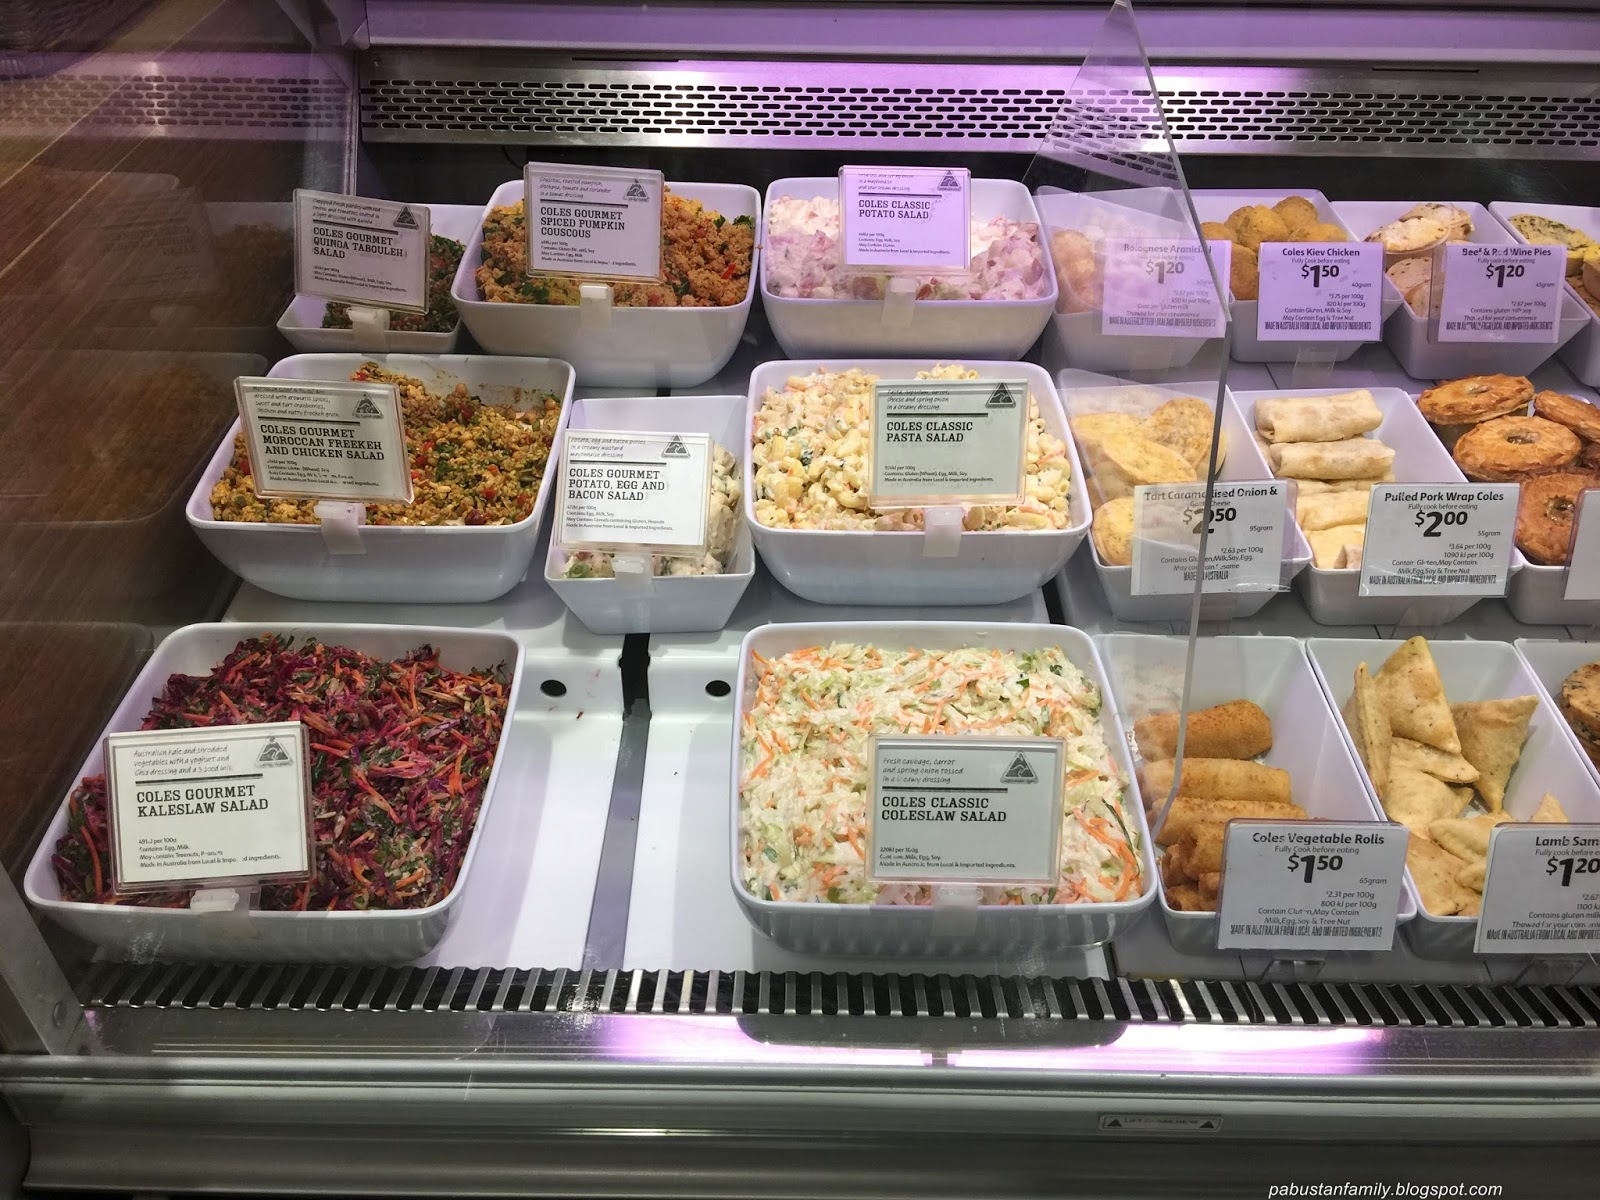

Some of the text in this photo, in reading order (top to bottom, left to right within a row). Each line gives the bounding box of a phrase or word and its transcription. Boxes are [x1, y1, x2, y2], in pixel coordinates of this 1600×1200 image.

[859, 200, 930, 209] COLES CLASSIC
[541, 207, 623, 220] COLES GOURMET
[859, 210, 929, 219] POTATO SALAD
[541, 217, 625, 230] SPICED PUMPKIN
[313, 227, 393, 245] COLES GOURMET
[541, 227, 591, 238] COUSCOUS
[313, 237, 403, 256] QUINOA TABOULEH
[1124, 244, 1168, 253] Bolognese
[1283, 248, 1359, 256] Coles Kiev Chicken
[1511, 248, 1532, 256] Wine
[1535, 248, 1551, 256] Pies
[313, 247, 345, 258] SALAD
[261, 425, 355, 438] COLES GOURMET
[887, 422, 973, 431] COLES CLASSIC
[263, 435, 382, 450] MOROCCAN FREEKEH
[887, 433, 963, 442] PASTA SALAD
[265, 446, 384, 460] AND CHICKEN SALAD
[570, 469, 660, 479] COLES GOURMET
[569, 479, 665, 490] POTATO, EGG AND
[568, 490, 644, 500] BACON SALAD
[1144, 492, 1165, 501] Tart
[1237, 488, 1267, 497] Onion
[1385, 492, 1504, 502] Pulled Pork Wrap Coles
[190, 757, 215, 765] yoghurt
[137, 785, 255, 803] COLES GOURMET
[138, 799, 268, 817] KALESLAW SALAD
[882, 797, 989, 808] COLES CLASSIC
[882, 810, 1006, 821] COLESLAW SALAD
[1253, 832, 1384, 845] Coles Vegetable Rolls
[1536, 836, 1569, 846] Lamb
[1359, 901, 1376, 909] 100g
